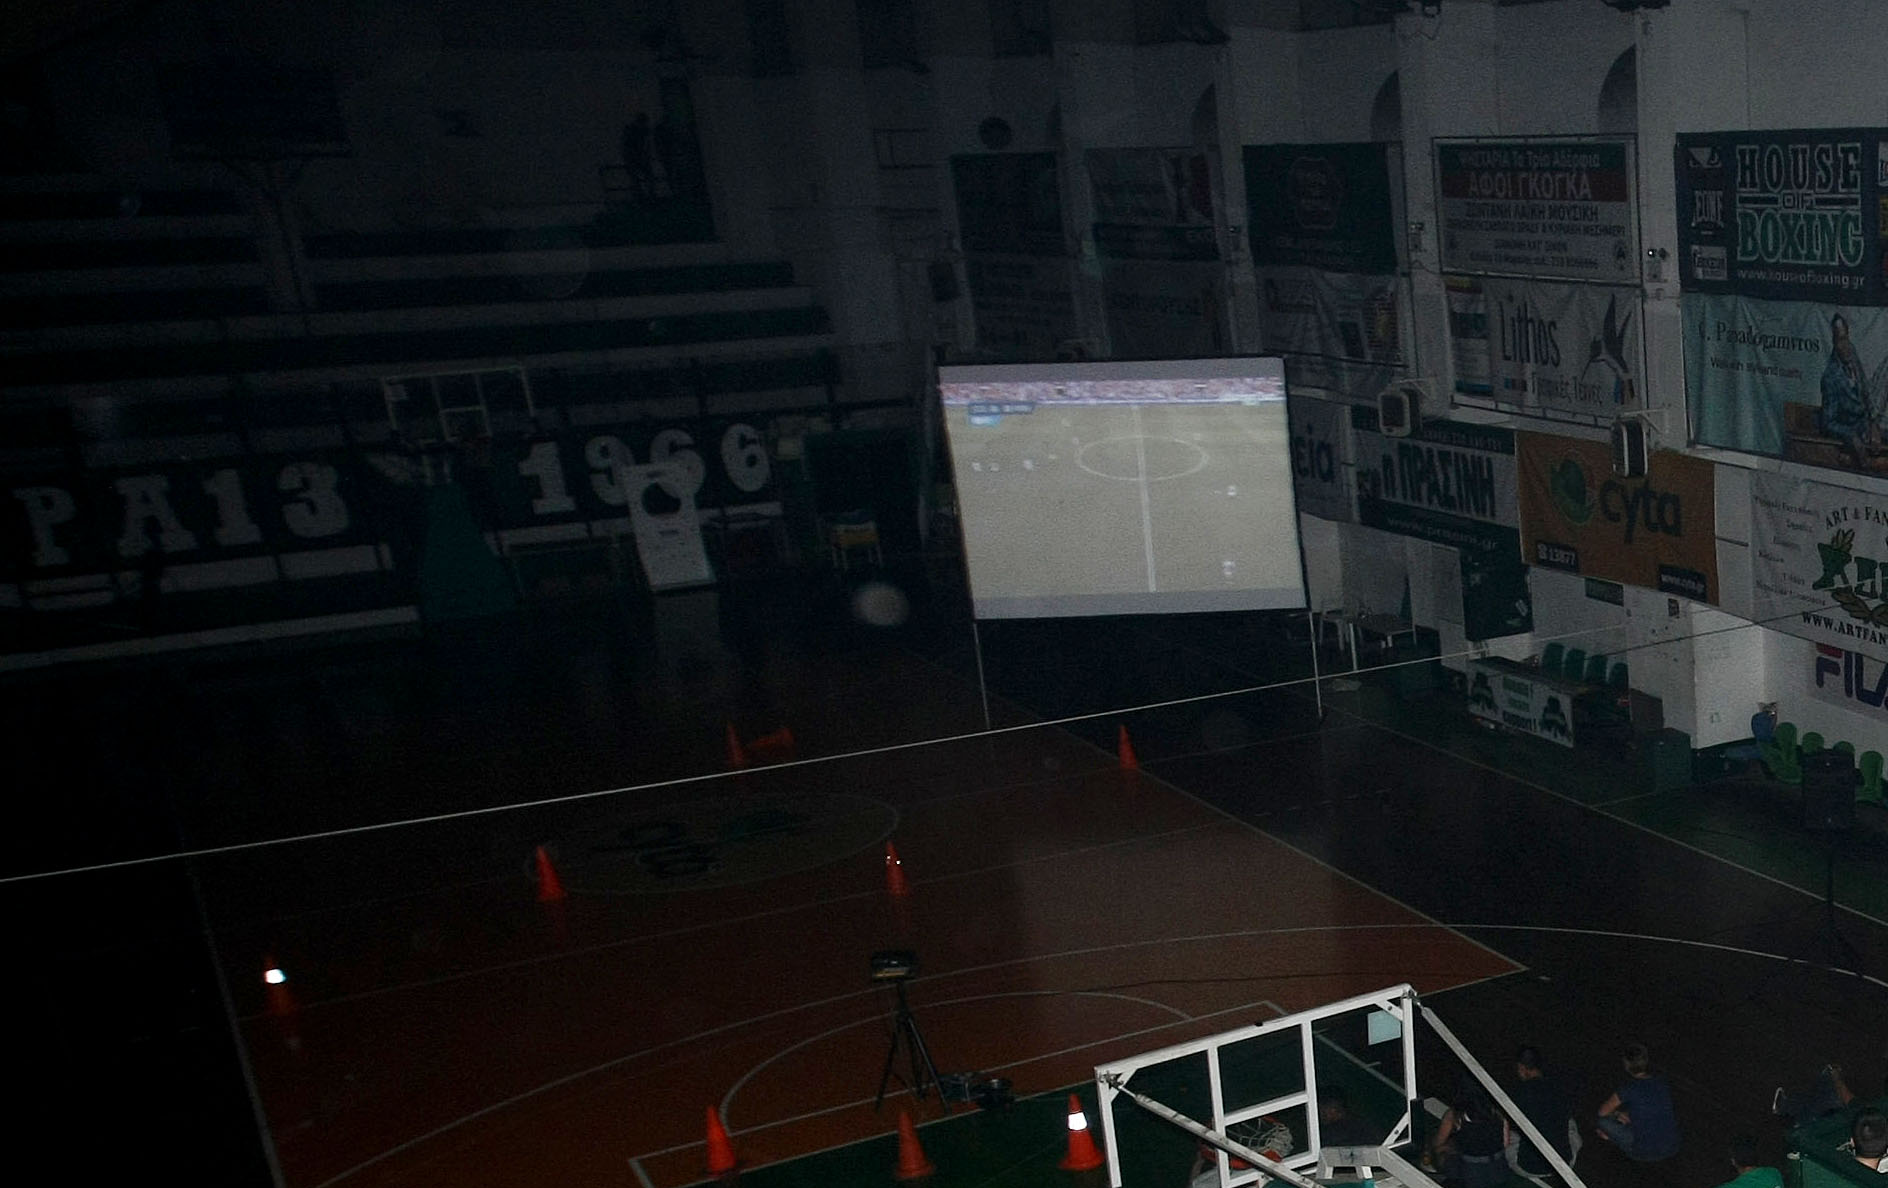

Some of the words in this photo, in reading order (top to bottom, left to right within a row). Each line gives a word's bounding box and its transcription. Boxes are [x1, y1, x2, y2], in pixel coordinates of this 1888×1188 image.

[1469, 172, 1512, 197] ΑΦΟΙ
[1518, 173, 1593, 199] ΓΚΟΓΚΑ
[1736, 142, 1861, 192] HOUSE
[1549, 205, 1598, 221] ΜΟΥΣΙΚΗ
[1736, 207, 1864, 267] BOXING
[1499, 301, 1560, 367] Lithos
[517, 422, 772, 517] 1966
[1398, 442, 1496, 518] ΠΡΑΣΙΝΗ
[1599, 478, 1681, 544] cyta
[1825, 509, 1849, 530] ART
